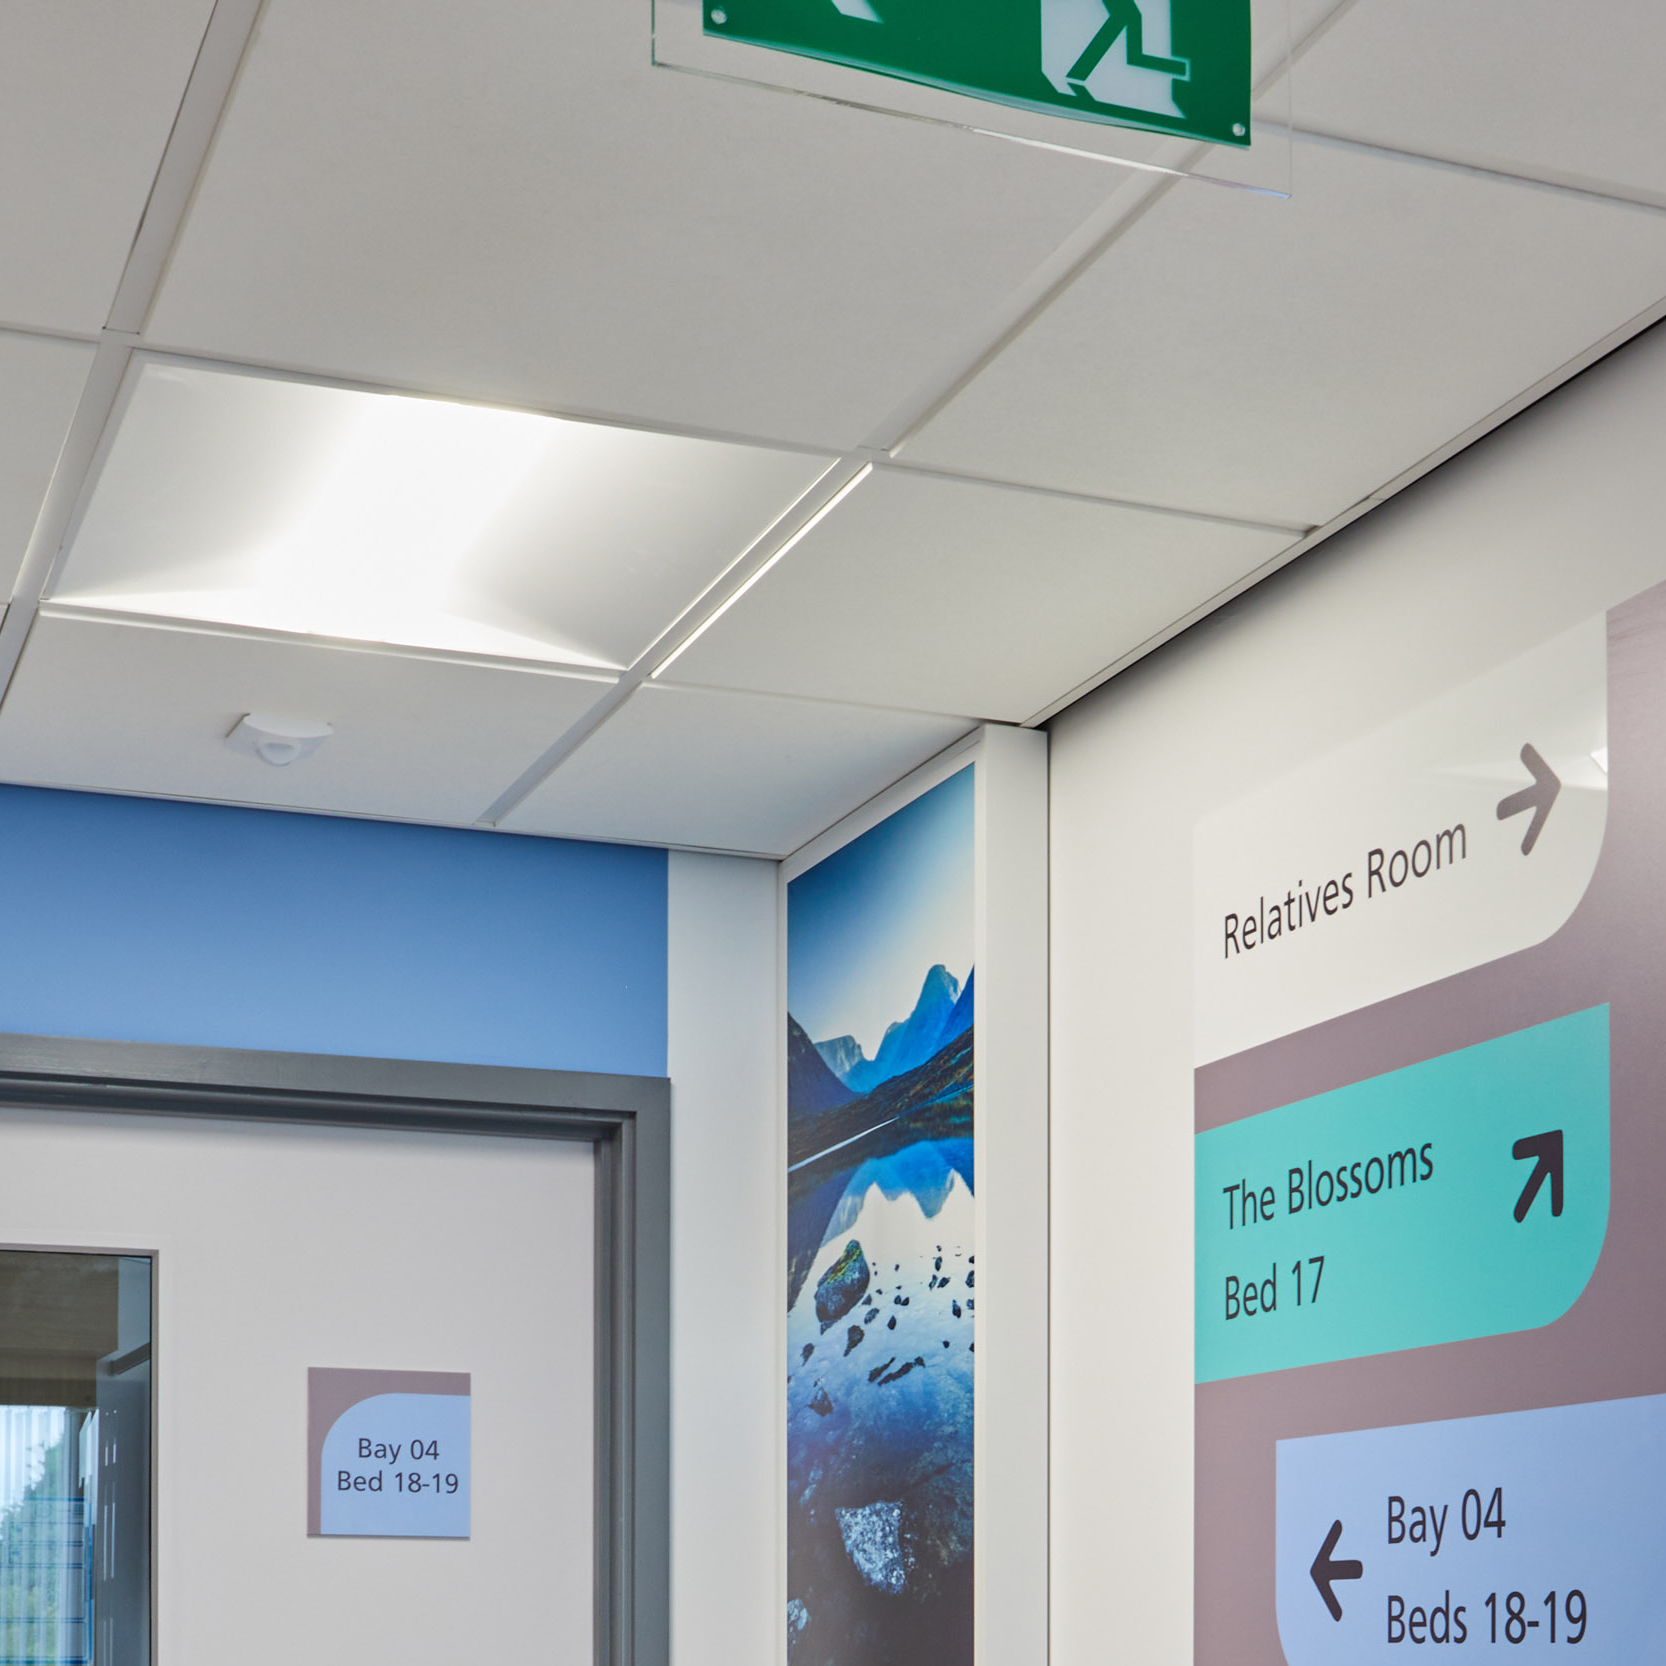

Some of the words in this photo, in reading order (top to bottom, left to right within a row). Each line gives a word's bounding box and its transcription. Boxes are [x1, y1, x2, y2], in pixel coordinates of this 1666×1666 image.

[1224, 872, 1354, 959] Relatives
[1367, 823, 1467, 899] Room
[1223, 1177, 1276, 1230] The
[1288, 1141, 1434, 1215] Blossoms
[1224, 1263, 1277, 1321] Bed
[1290, 1255, 1325, 1306] 17
[338, 1470, 383, 1492] Bed
[395, 1472, 459, 1494] 18-19
[358, 1437, 402, 1465] Bay
[410, 1439, 440, 1460] 04
[1387, 1495, 1449, 1557] Bay
[1461, 1487, 1506, 1541] 04
[1386, 1589, 1468, 1645] Beds
[1484, 1589, 1588, 1645] 18-19
